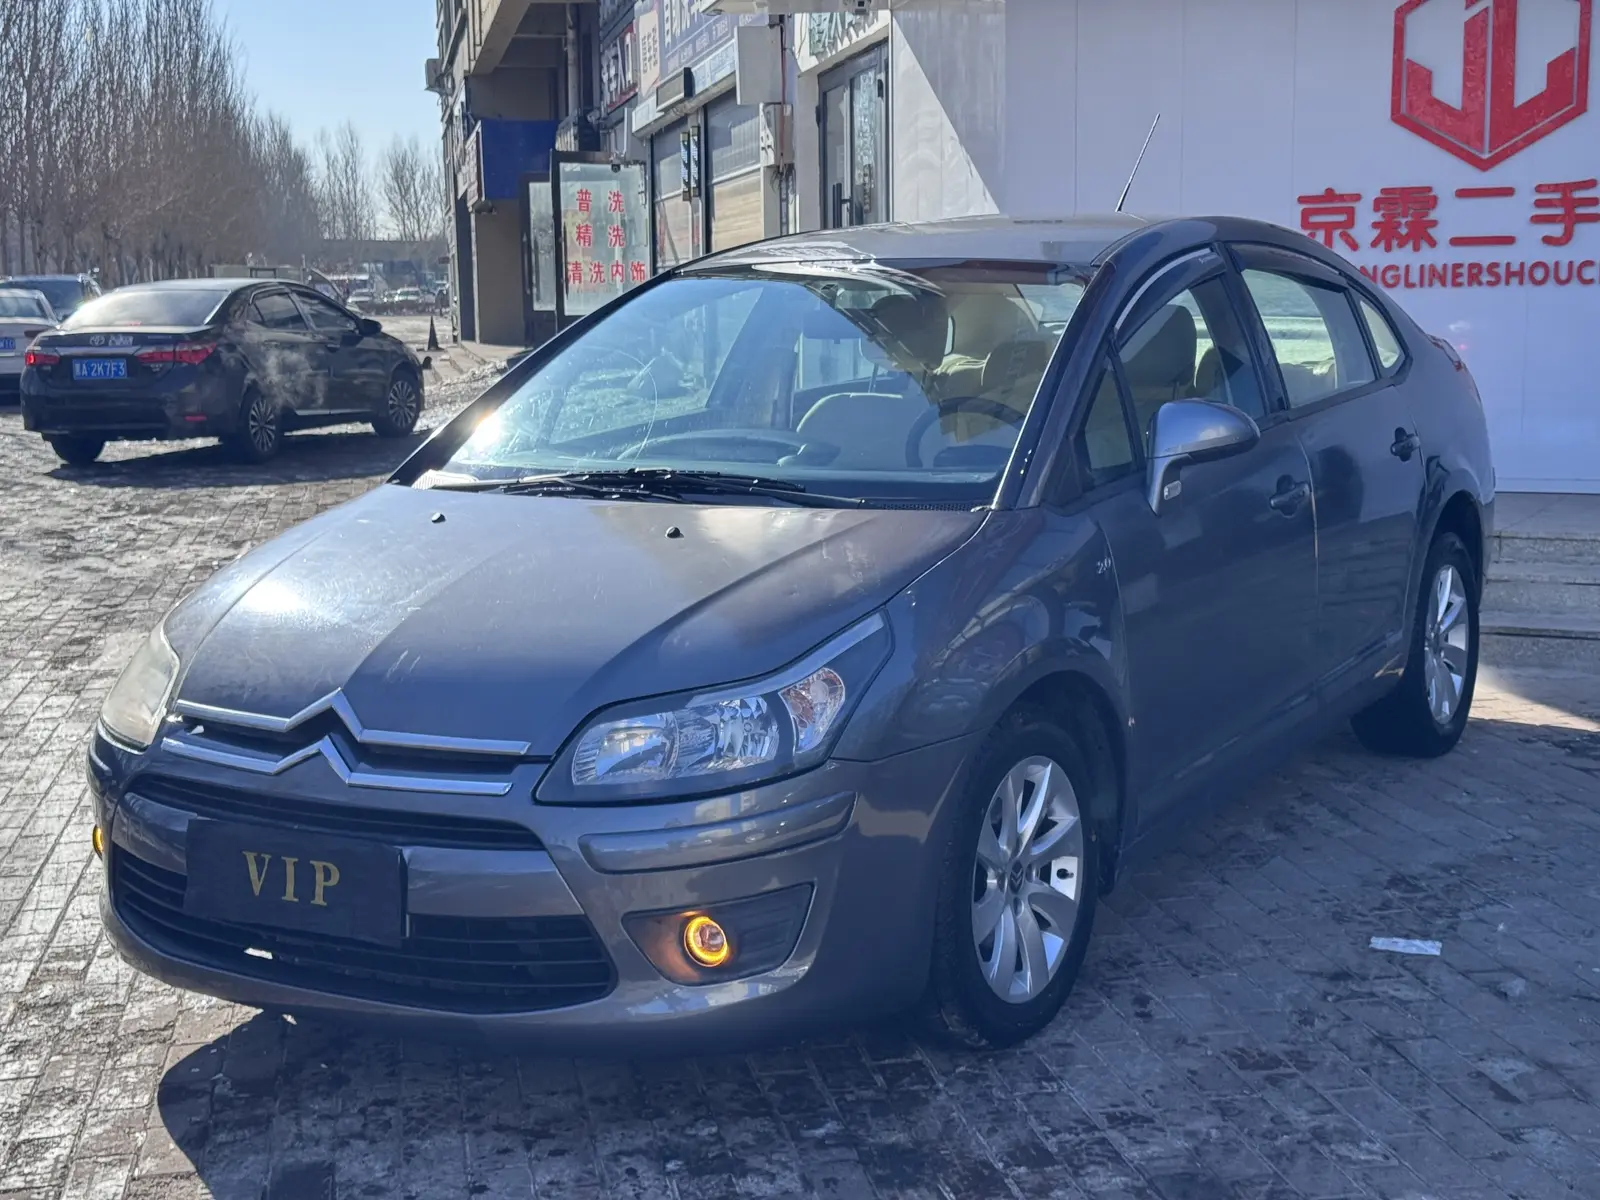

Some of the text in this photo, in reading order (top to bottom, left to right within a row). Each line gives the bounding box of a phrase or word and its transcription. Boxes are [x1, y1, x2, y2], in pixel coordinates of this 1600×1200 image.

[1297, 178, 1600, 253] 京霖二手
[566, 260, 646, 284] 清洗内饰
[1360, 259, 1600, 289] NGLINERSHOUC
[242, 850, 341, 906] VIP
